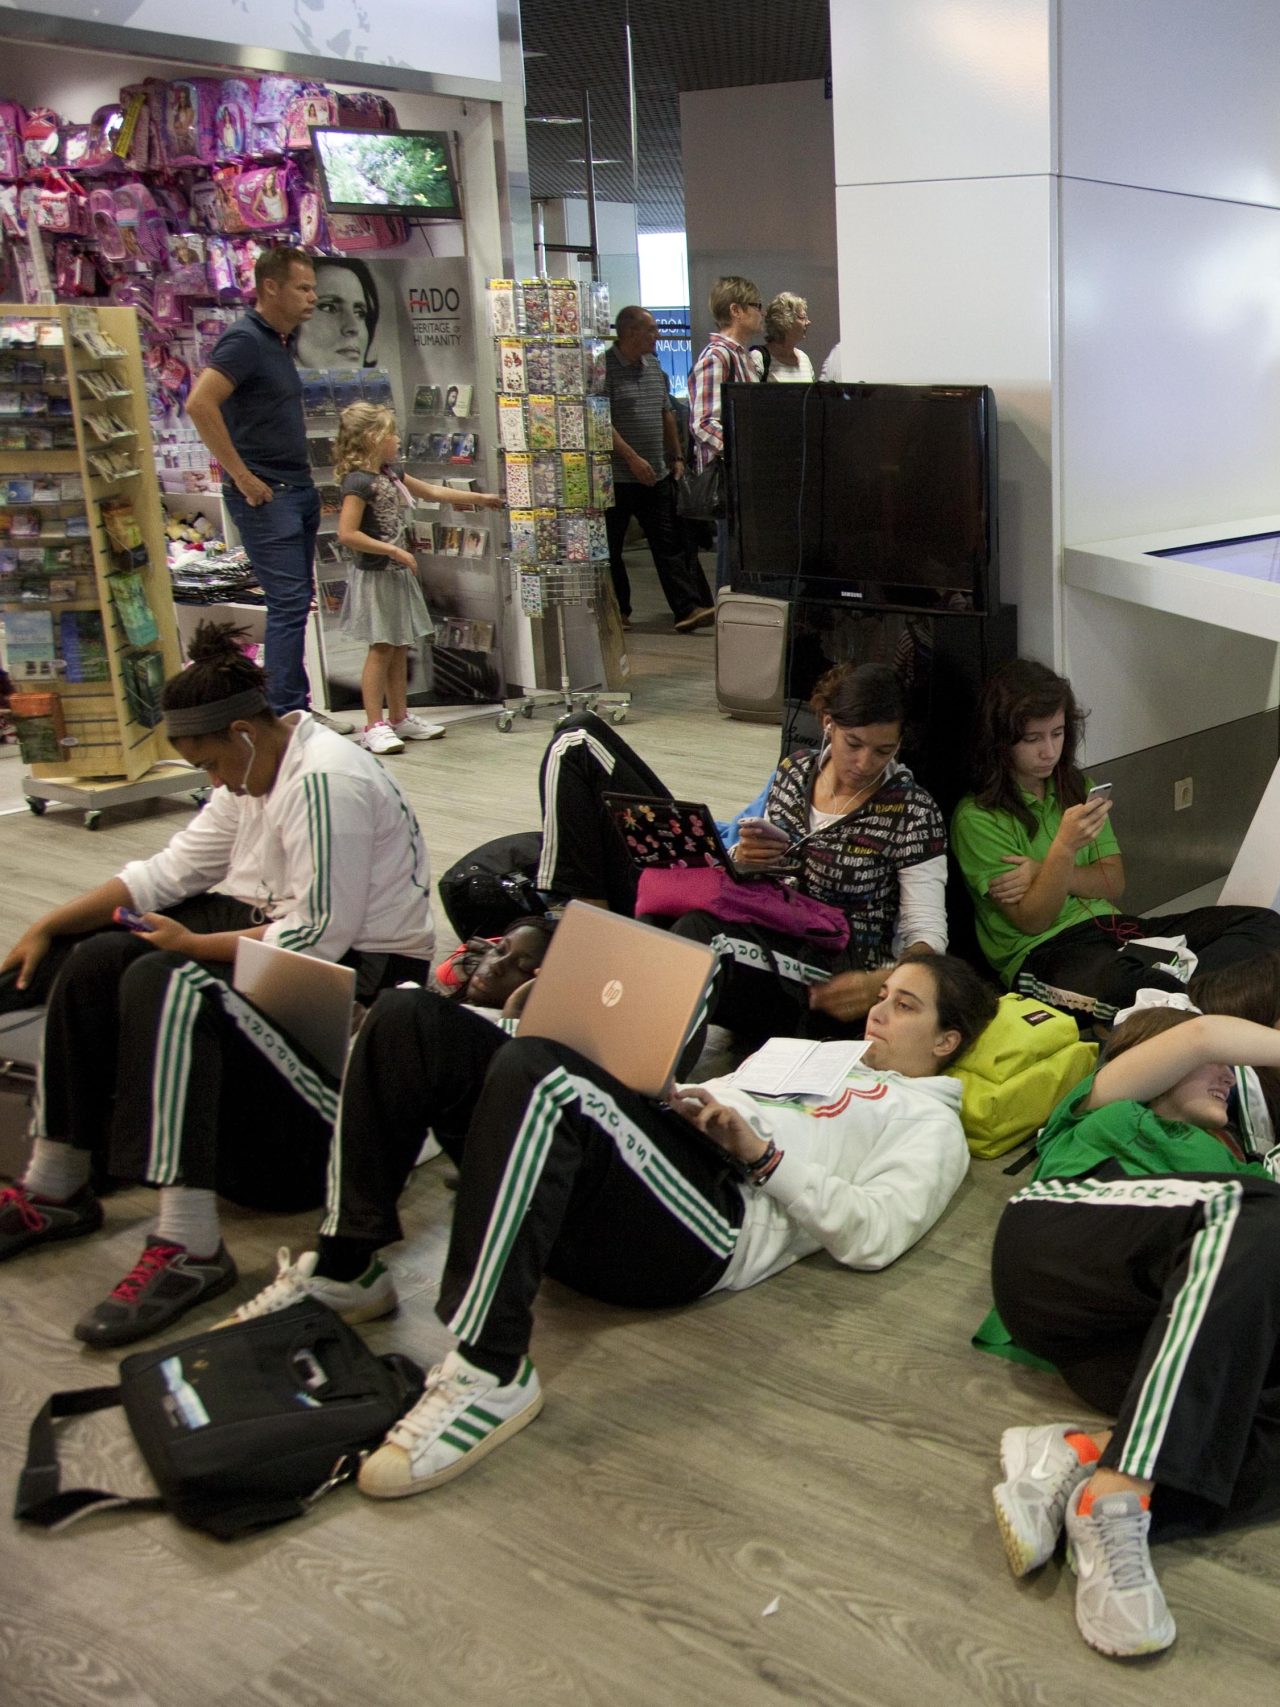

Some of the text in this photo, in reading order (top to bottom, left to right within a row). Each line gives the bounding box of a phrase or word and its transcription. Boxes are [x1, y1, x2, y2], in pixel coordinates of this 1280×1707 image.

[409, 287, 460, 313] FADO
[413, 322, 450, 334] HERITAGE
[413, 334, 462, 347] HUMANITY
[854, 866, 885, 881] PARIS
[603, 980, 622, 1007] hp
